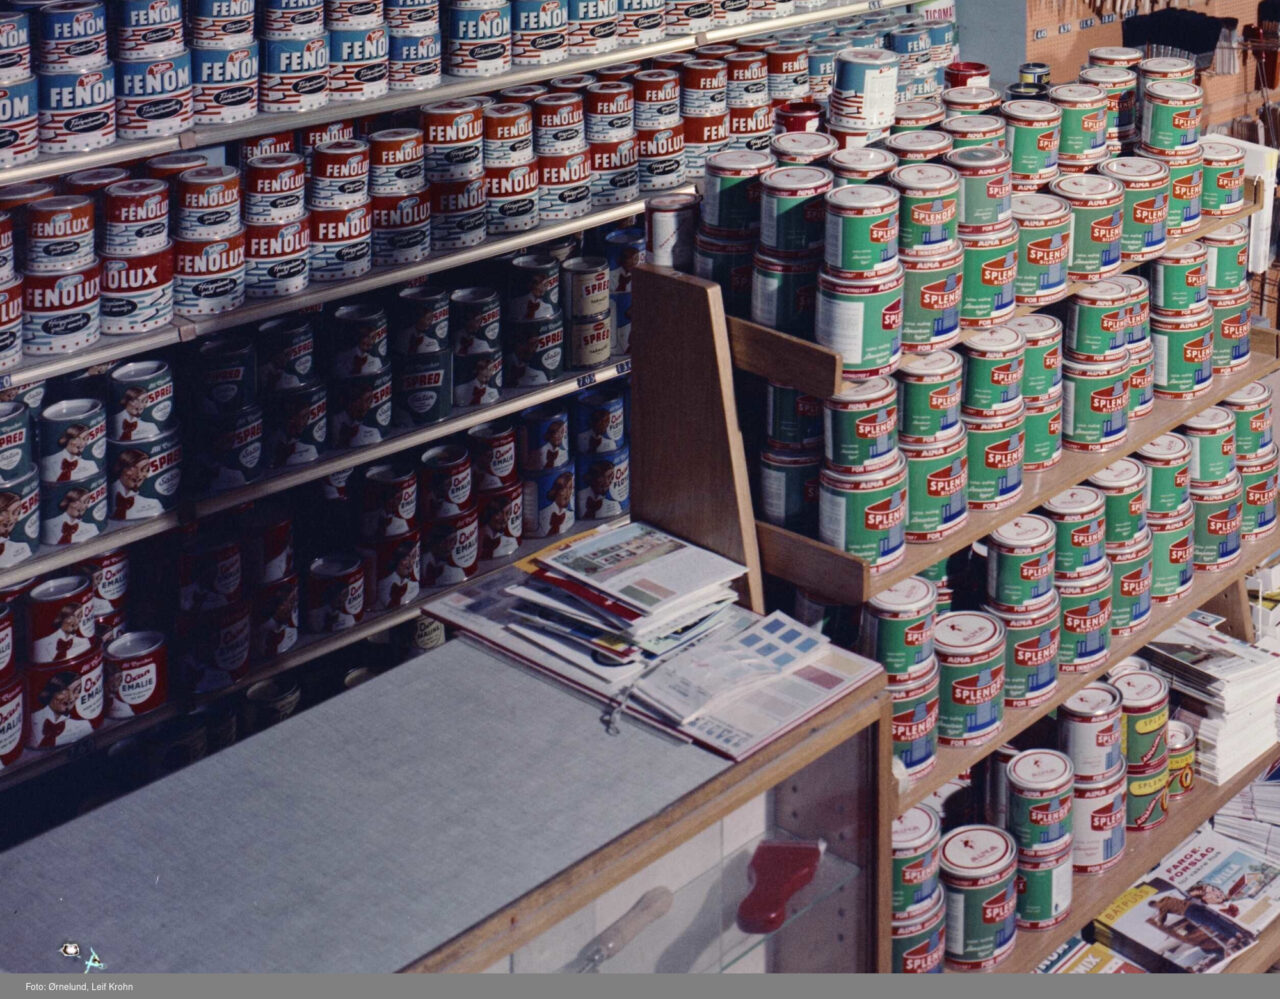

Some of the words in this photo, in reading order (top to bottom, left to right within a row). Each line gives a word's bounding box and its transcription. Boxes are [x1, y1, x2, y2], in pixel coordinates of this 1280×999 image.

[50, 78, 115, 108] FENOM
[123, 66, 190, 95] FENOM
[185, 189, 239, 208] FENOLUX
[31, 216, 90, 237] FENOLUX
[177, 244, 245, 273] FENOLUX
[26, 276, 101, 308] FENOLUX
[1169, 847, 1215, 882] FORSLAG
